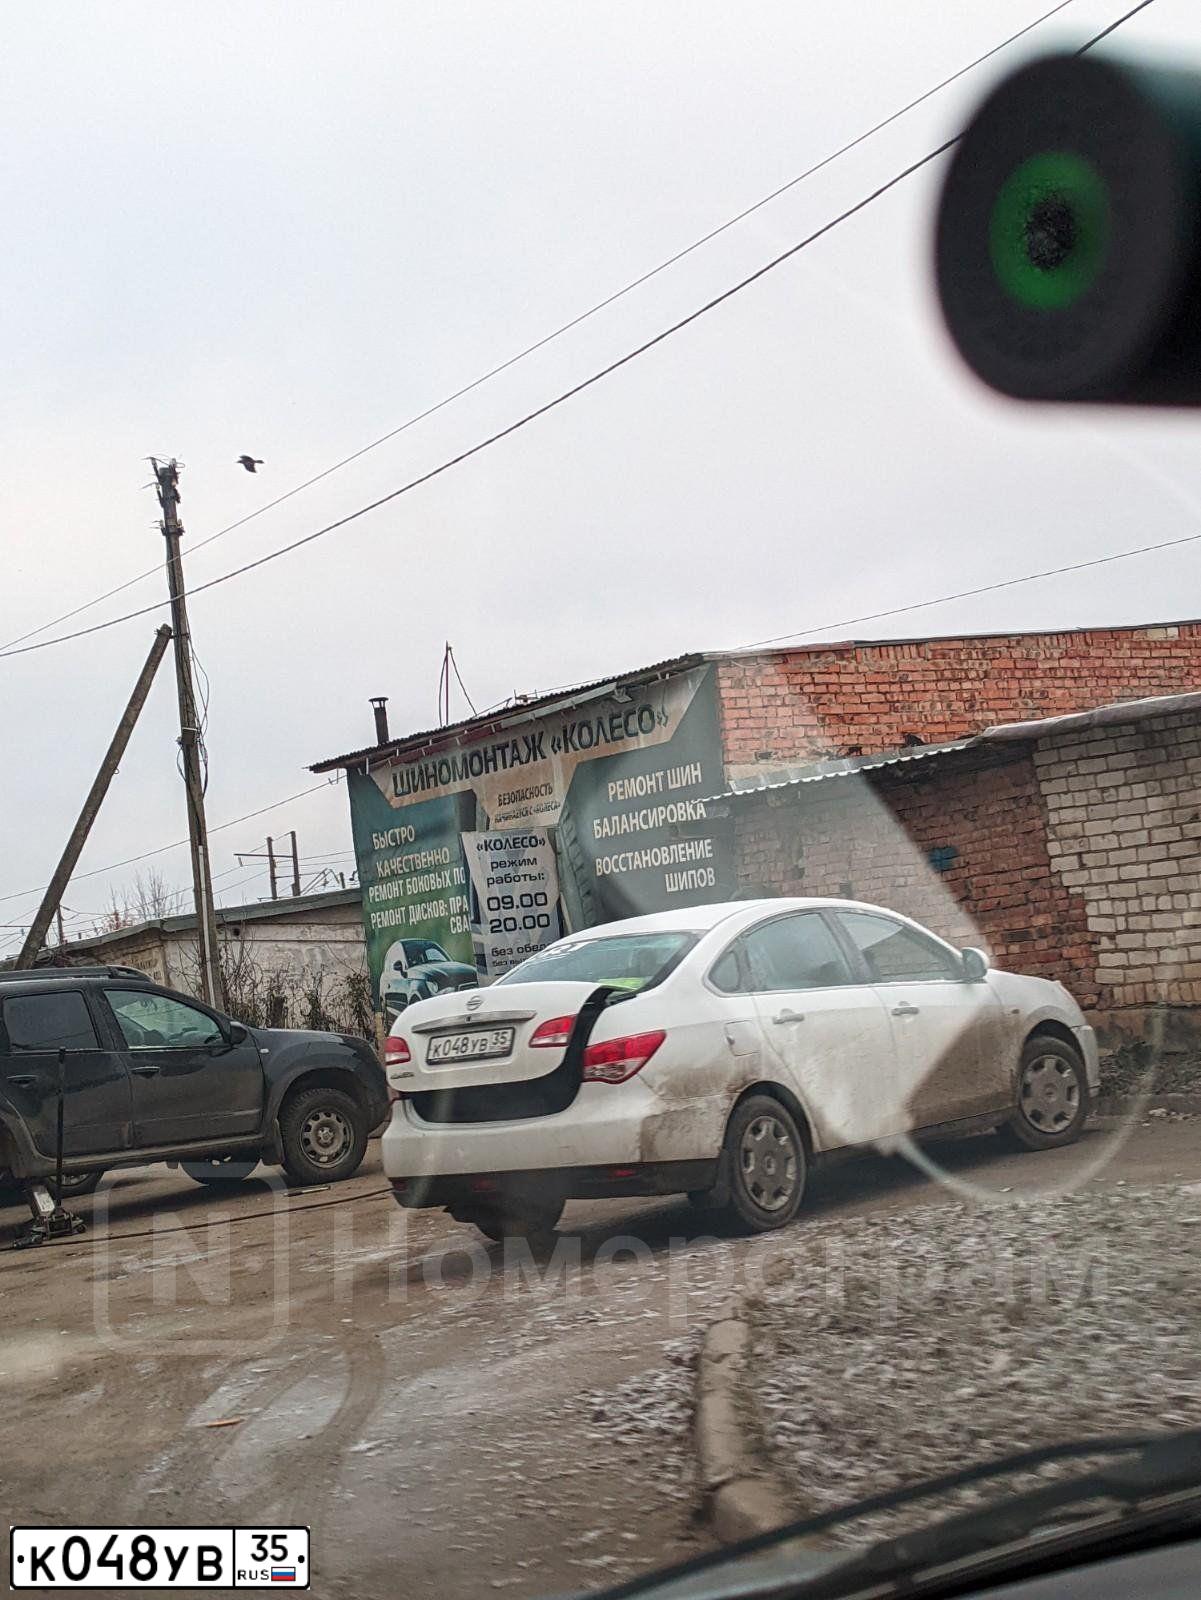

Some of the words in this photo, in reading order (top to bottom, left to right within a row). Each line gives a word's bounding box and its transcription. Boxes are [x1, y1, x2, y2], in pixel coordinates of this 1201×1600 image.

[392, 730, 548, 798] ШИНОМОНТАЖ
[550, 703, 669, 755] «КОЛЕСО»
[497, 782, 554, 807] БЕЗОПАСНОСТЬ
[607, 771, 664, 803] РЕМОНТ
[666, 762, 703, 790] ШИН
[593, 799, 707, 840] БАЛАНСИРОВКА
[372, 825, 416, 850] БЫСТРО
[476, 835, 546, 852] «КОЛЕСО»
[376, 846, 450, 878] КАЧЕСТВЕННО
[490, 858, 538, 872] режим
[595, 839, 714, 877] ВОССТАНОВЛЕНИЕ
[368, 879, 404, 903] РЕМОНТ
[406, 870, 452, 896] БОКОВЫХ
[486, 872, 545, 888] работы:
[665, 867, 716, 893] ШИПОВ
[486, 892, 548, 911] 09.00
[370, 906, 406, 929] РЕМОНТ
[408, 900, 449, 926] ДИСКОВ:
[489, 913, 551, 934] 20.00
[491, 947, 513, 957] без
[492, 1031, 508, 1045] 35
